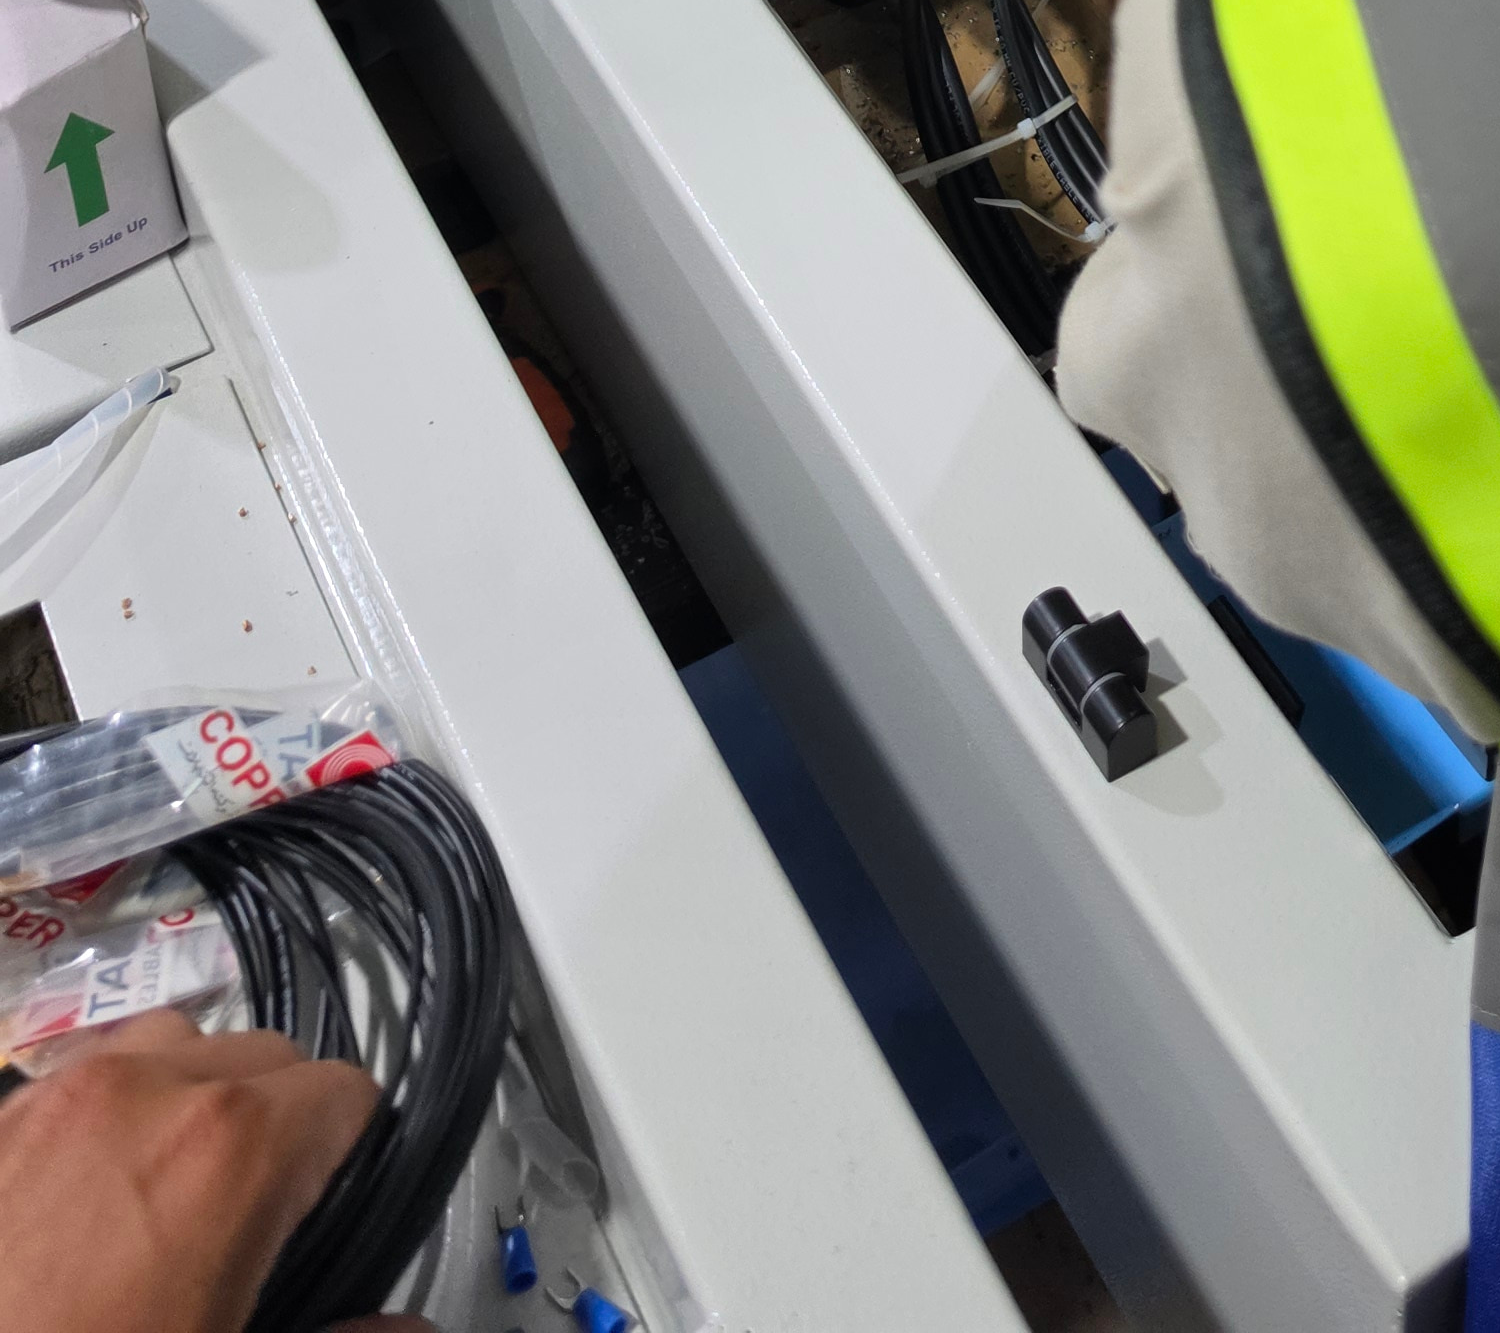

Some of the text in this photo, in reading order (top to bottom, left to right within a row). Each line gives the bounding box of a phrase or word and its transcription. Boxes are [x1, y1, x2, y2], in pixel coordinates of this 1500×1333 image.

[48, 215, 149, 275] This Side Up
